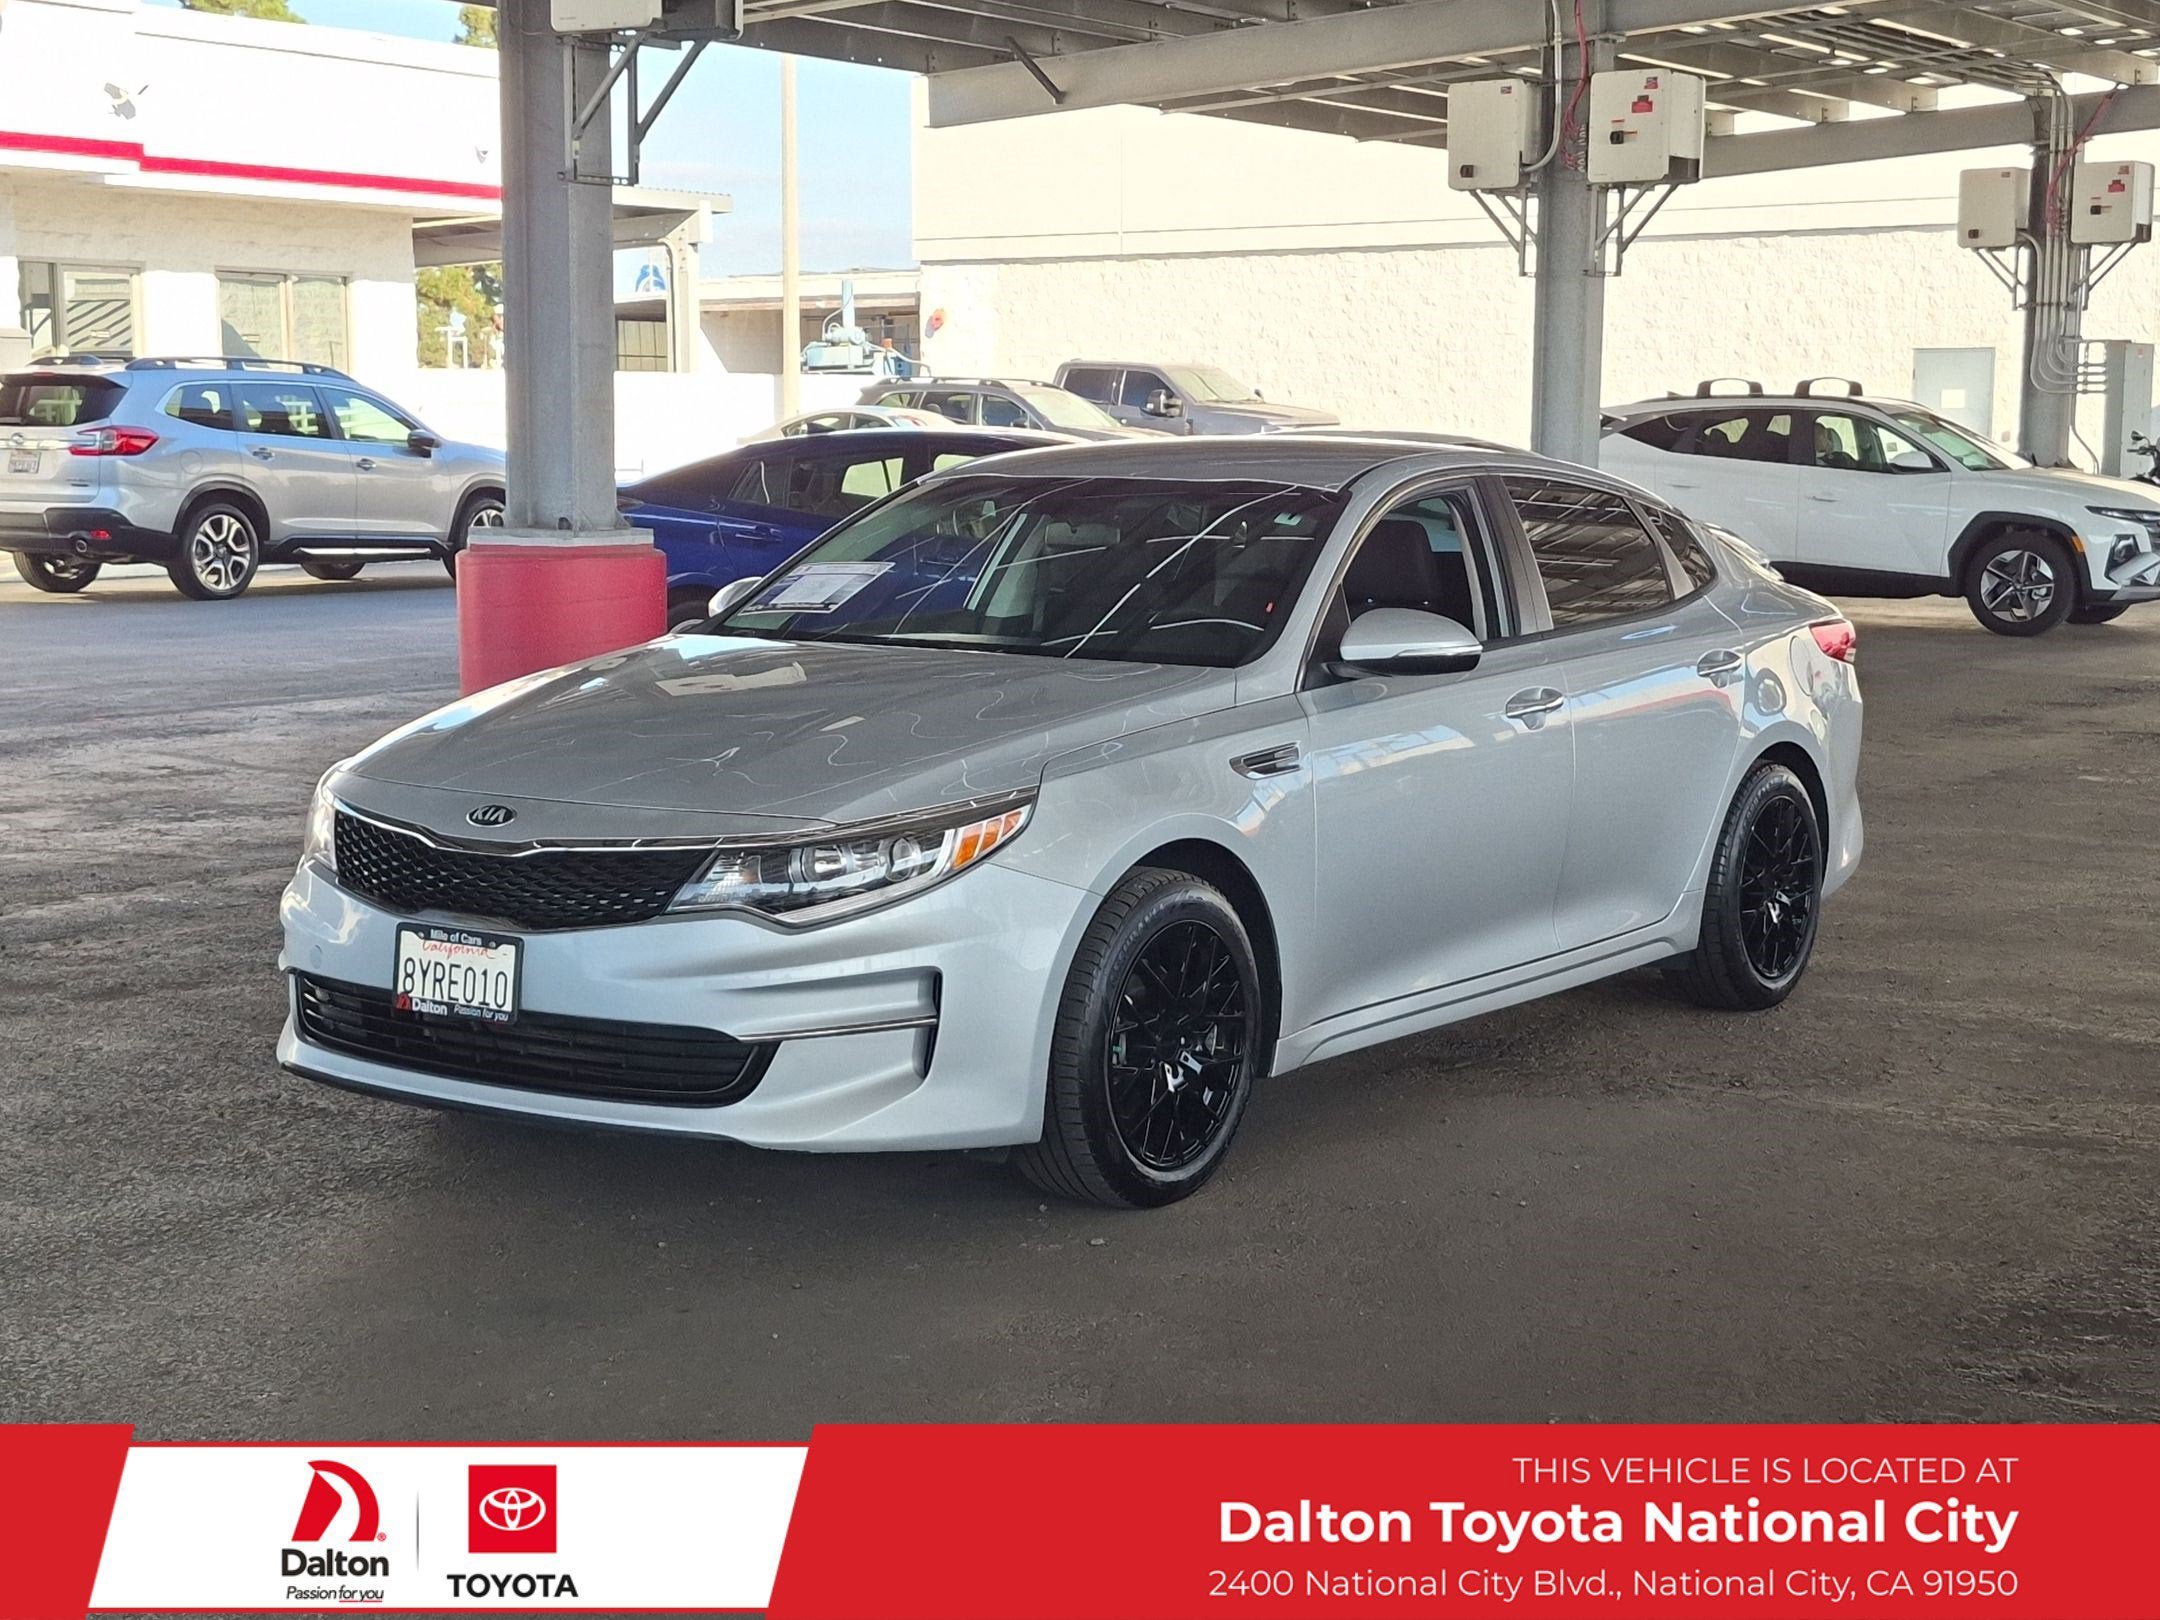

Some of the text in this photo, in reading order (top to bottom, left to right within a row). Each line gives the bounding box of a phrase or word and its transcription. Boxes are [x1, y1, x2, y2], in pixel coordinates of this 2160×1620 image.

[472, 806, 507, 823] KIA
[430, 928, 483, 946] Mile of Cars
[422, 939, 496, 960] California
[402, 956, 508, 1009] 8YRE010
[412, 997, 509, 1022] Dalton Passion for you
